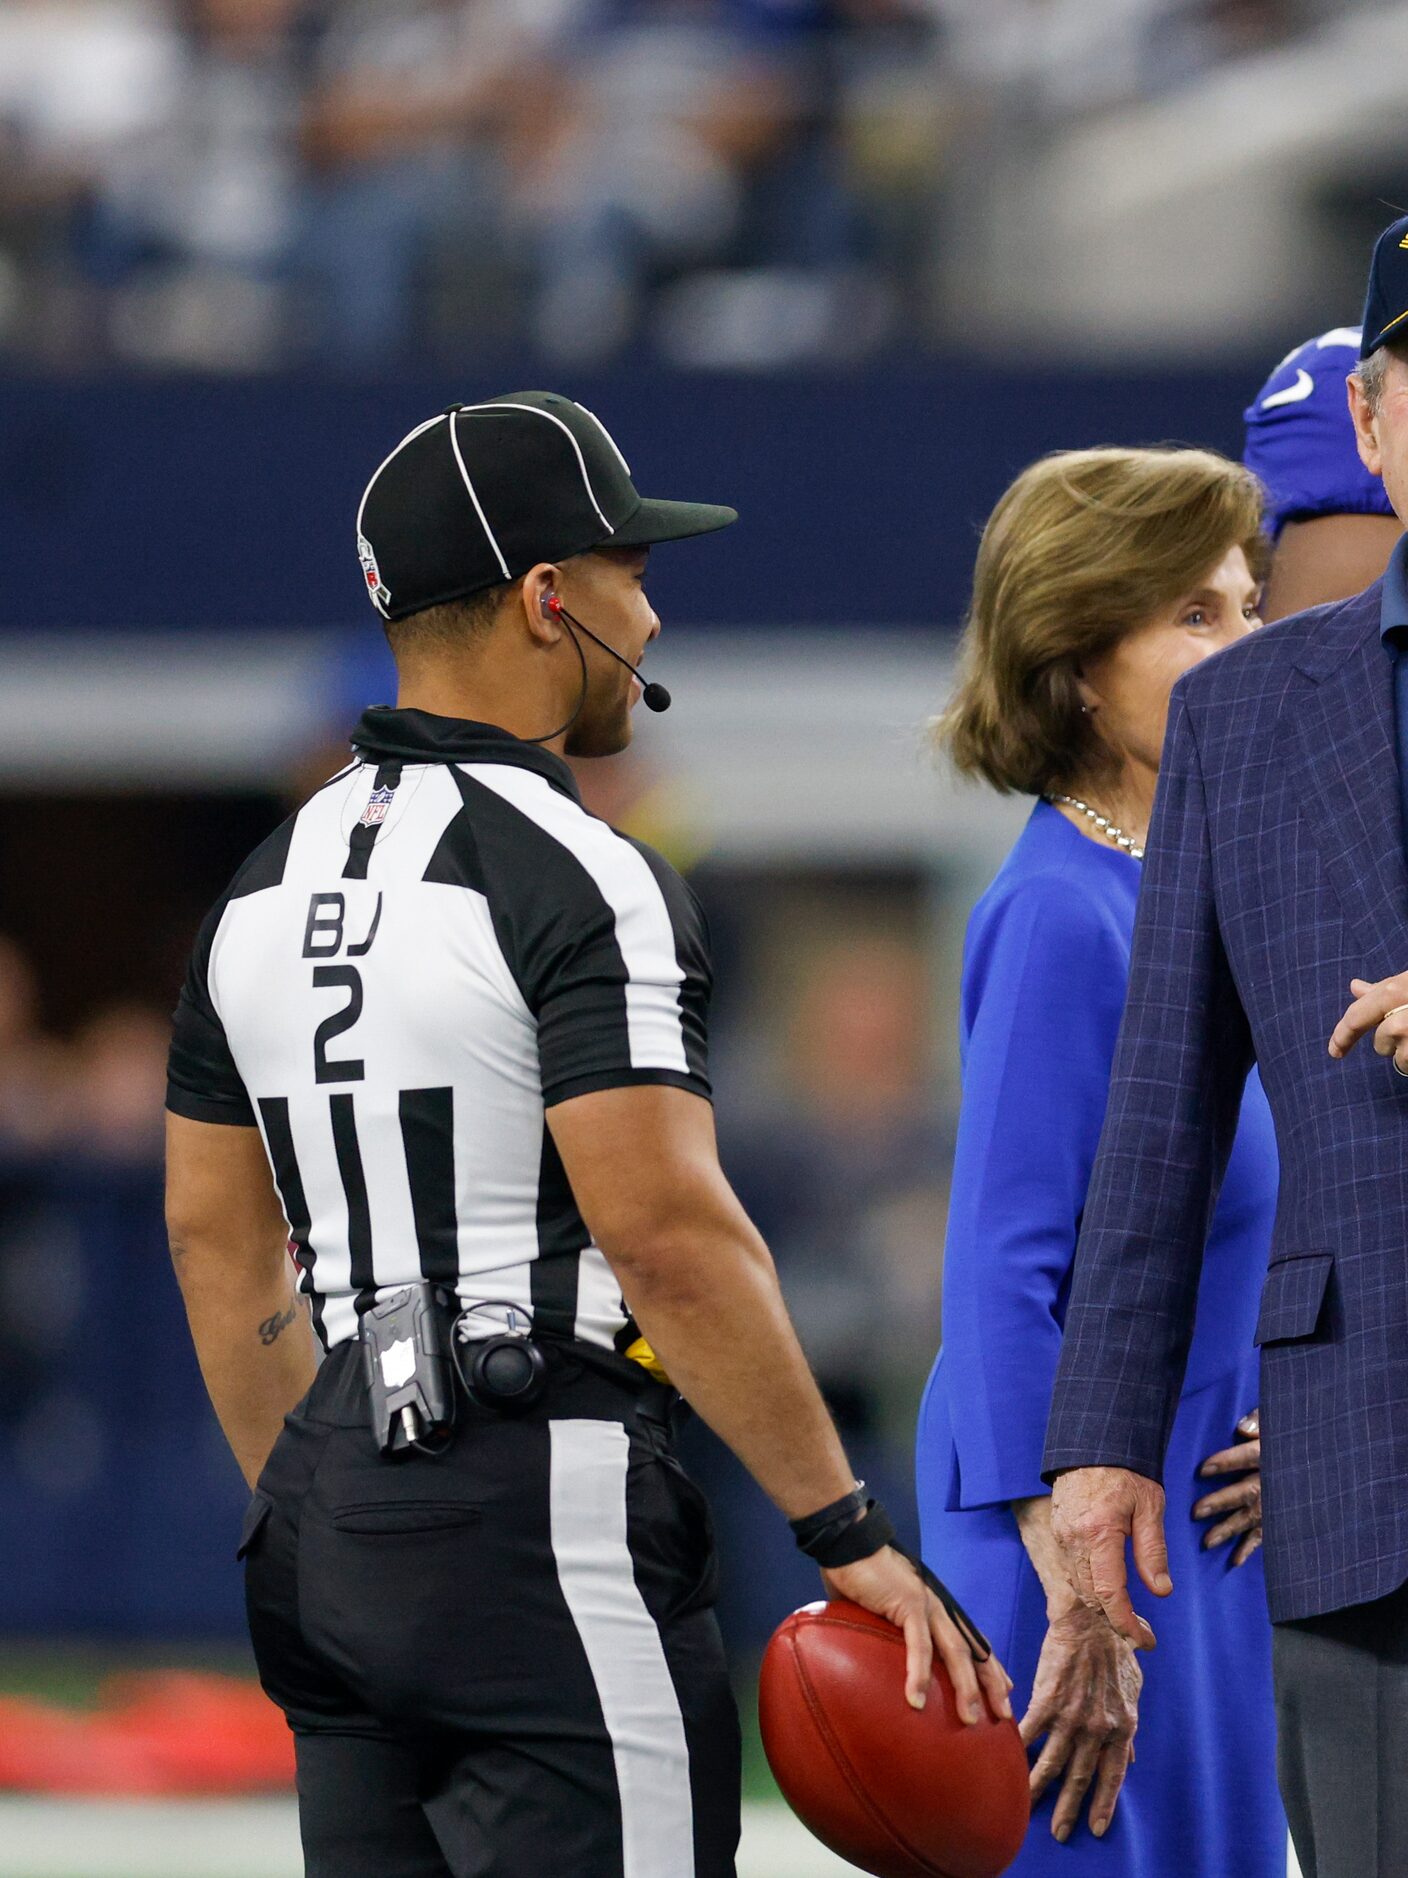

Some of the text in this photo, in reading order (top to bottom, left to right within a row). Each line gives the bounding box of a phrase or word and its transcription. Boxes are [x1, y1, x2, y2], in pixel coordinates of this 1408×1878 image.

[363, 804, 385, 821] NFL
[302, 891, 383, 958] BJ
[312, 964, 365, 1084] 2
